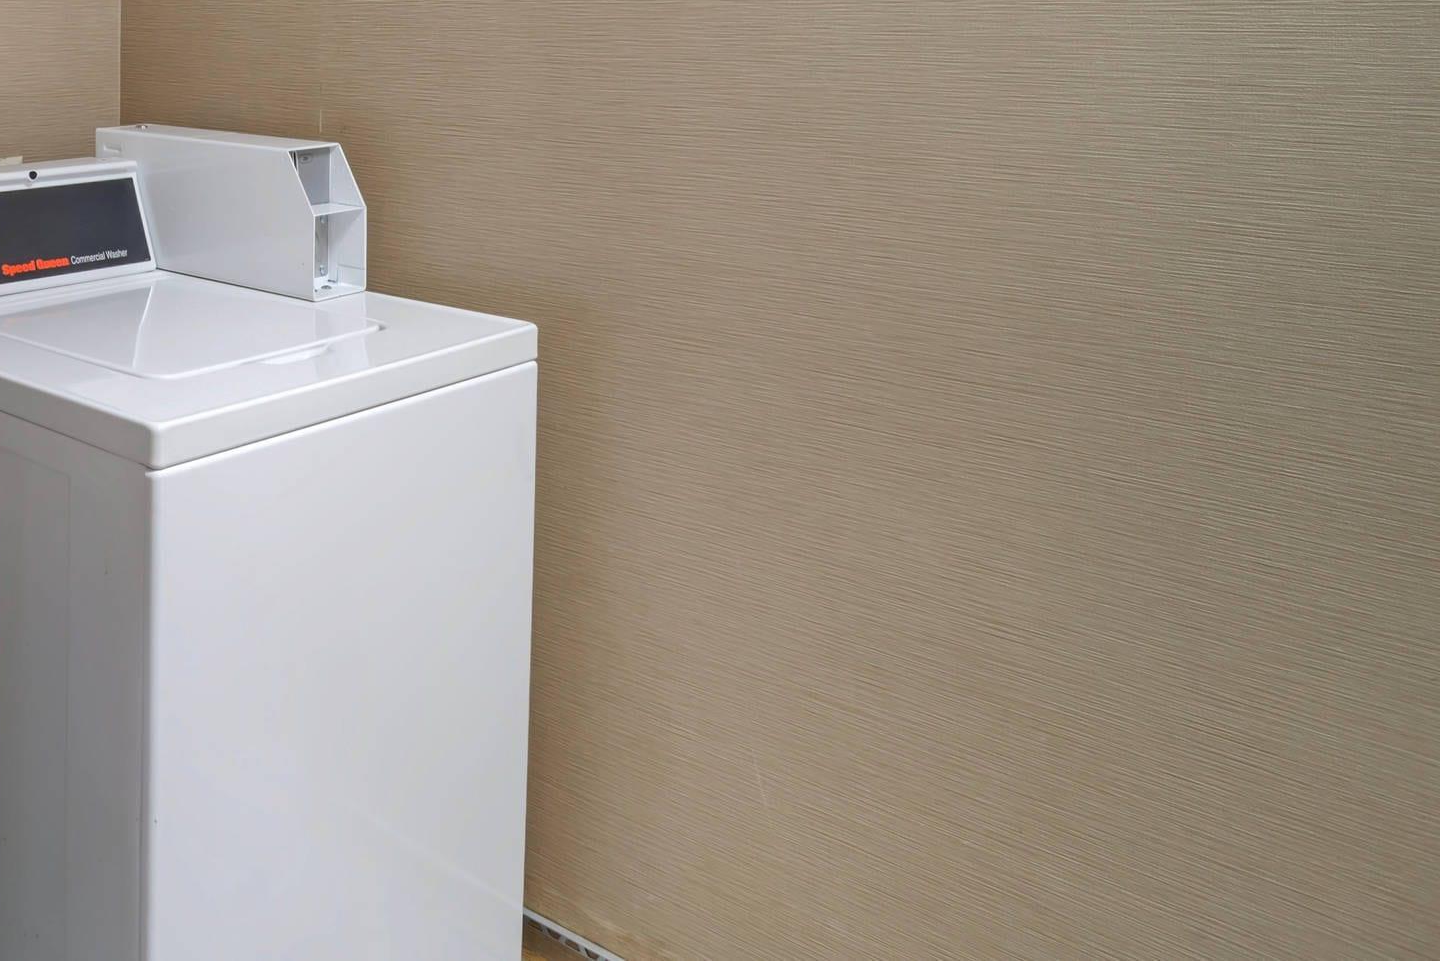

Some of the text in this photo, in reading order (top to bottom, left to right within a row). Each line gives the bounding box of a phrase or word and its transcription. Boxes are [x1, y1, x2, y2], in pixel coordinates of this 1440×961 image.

[1, 260, 35, 276] Speed
[71, 251, 105, 265] Commercial
[105, 248, 128, 260] Washer
